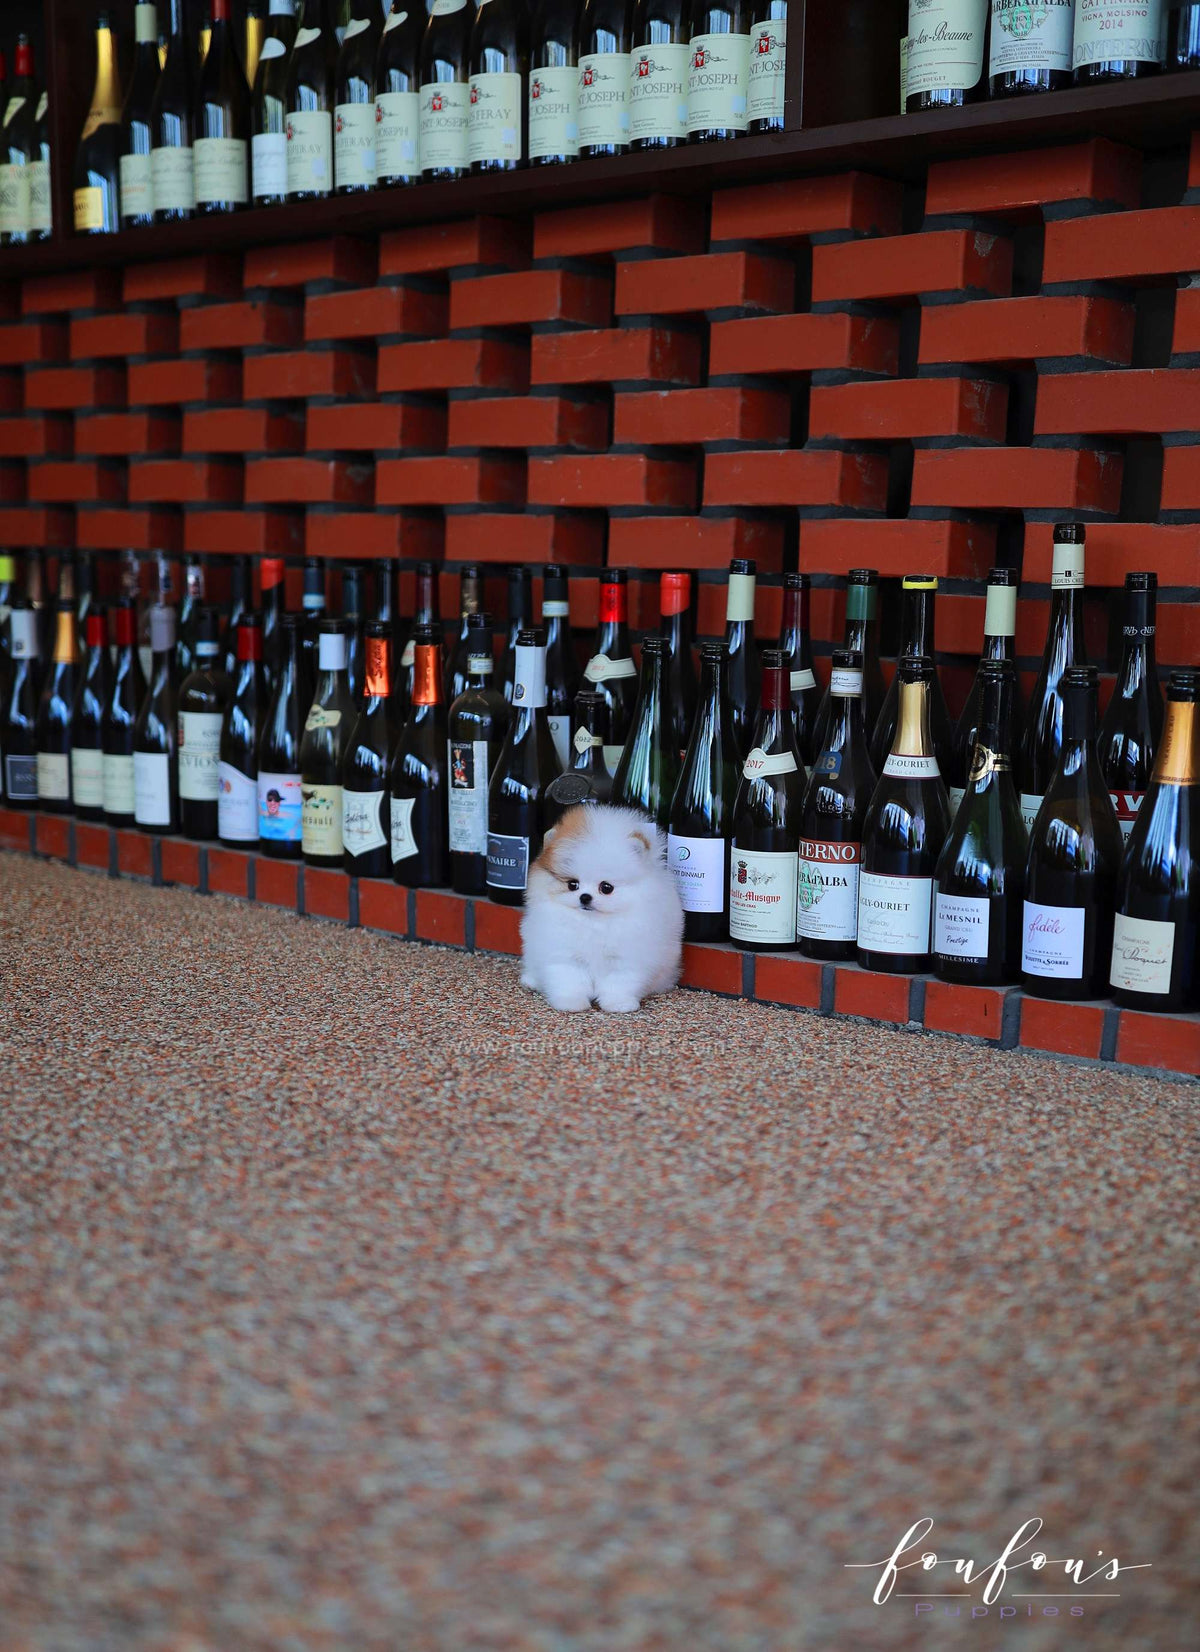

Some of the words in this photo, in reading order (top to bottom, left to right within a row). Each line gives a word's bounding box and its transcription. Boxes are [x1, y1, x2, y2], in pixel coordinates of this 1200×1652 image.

[1081, 12, 1103, 22] VIGNA
[1099, 19, 1123, 30] 2014
[746, 758, 765, 769] 2017
[801, 842, 855, 860] TERNO
[940, 903, 979, 913] CHAMPAGNE
[946, 914, 983, 925] MESNIL
[946, 934, 968, 946] Prestige
[939, 954, 979, 964] MILLESIME
